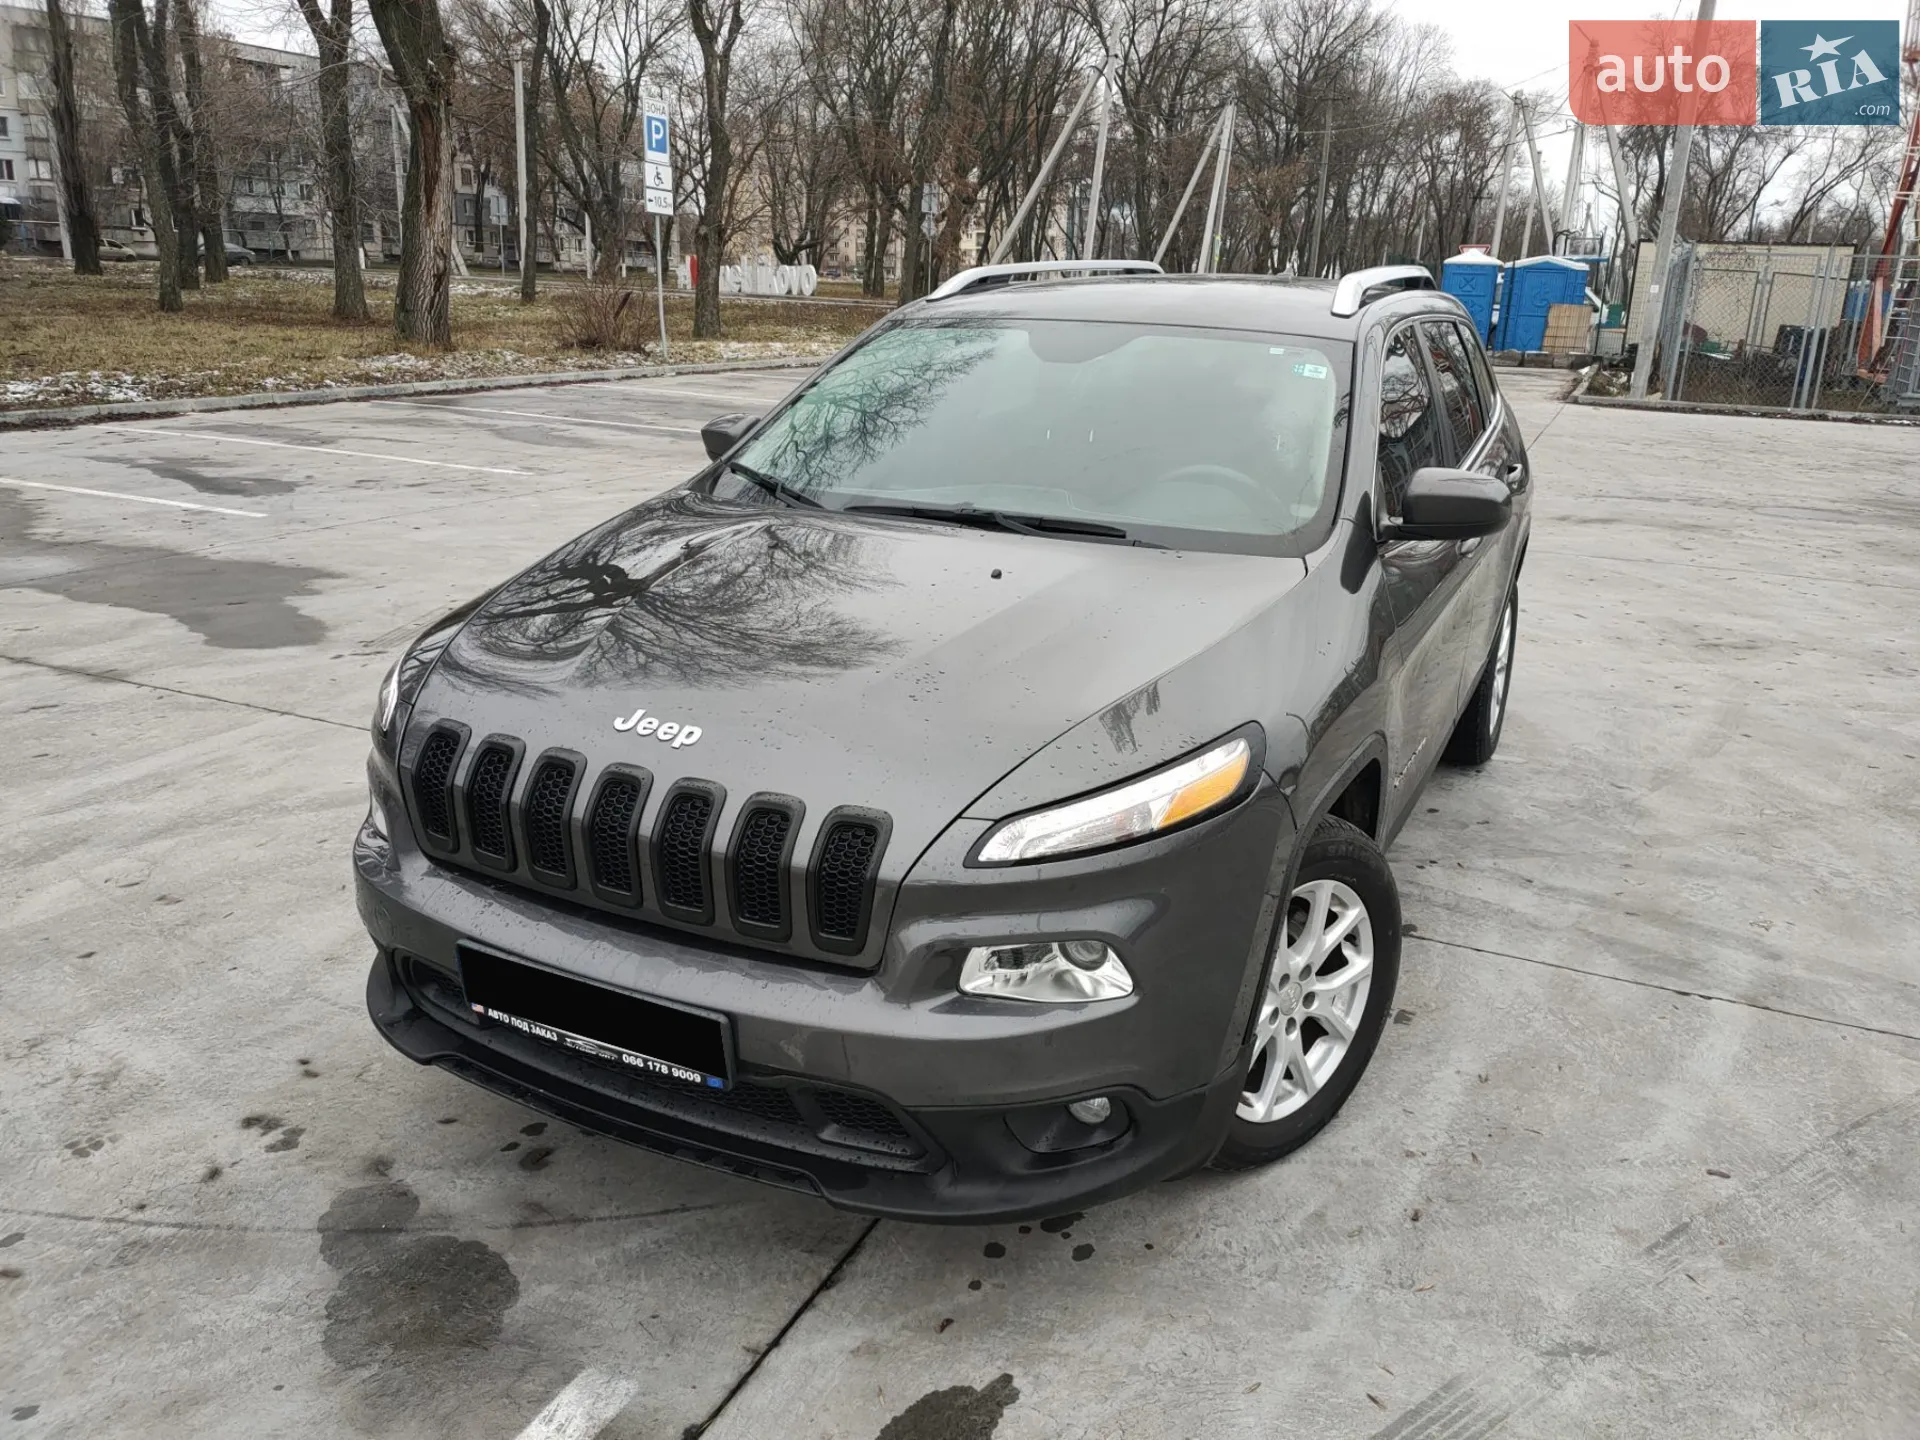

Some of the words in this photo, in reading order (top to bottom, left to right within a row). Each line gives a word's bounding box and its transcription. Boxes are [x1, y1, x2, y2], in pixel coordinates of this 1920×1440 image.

[651, 119, 664, 149] P
[613, 708, 703, 749] Jeep
[488, 1008, 510, 1023] АВТО
[510, 1016, 530, 1033] ПОД
[530, 1024, 558, 1041] ЗАКАЗ
[646, 1060, 669, 1075] 178
[671, 1067, 701, 1084] 9009
